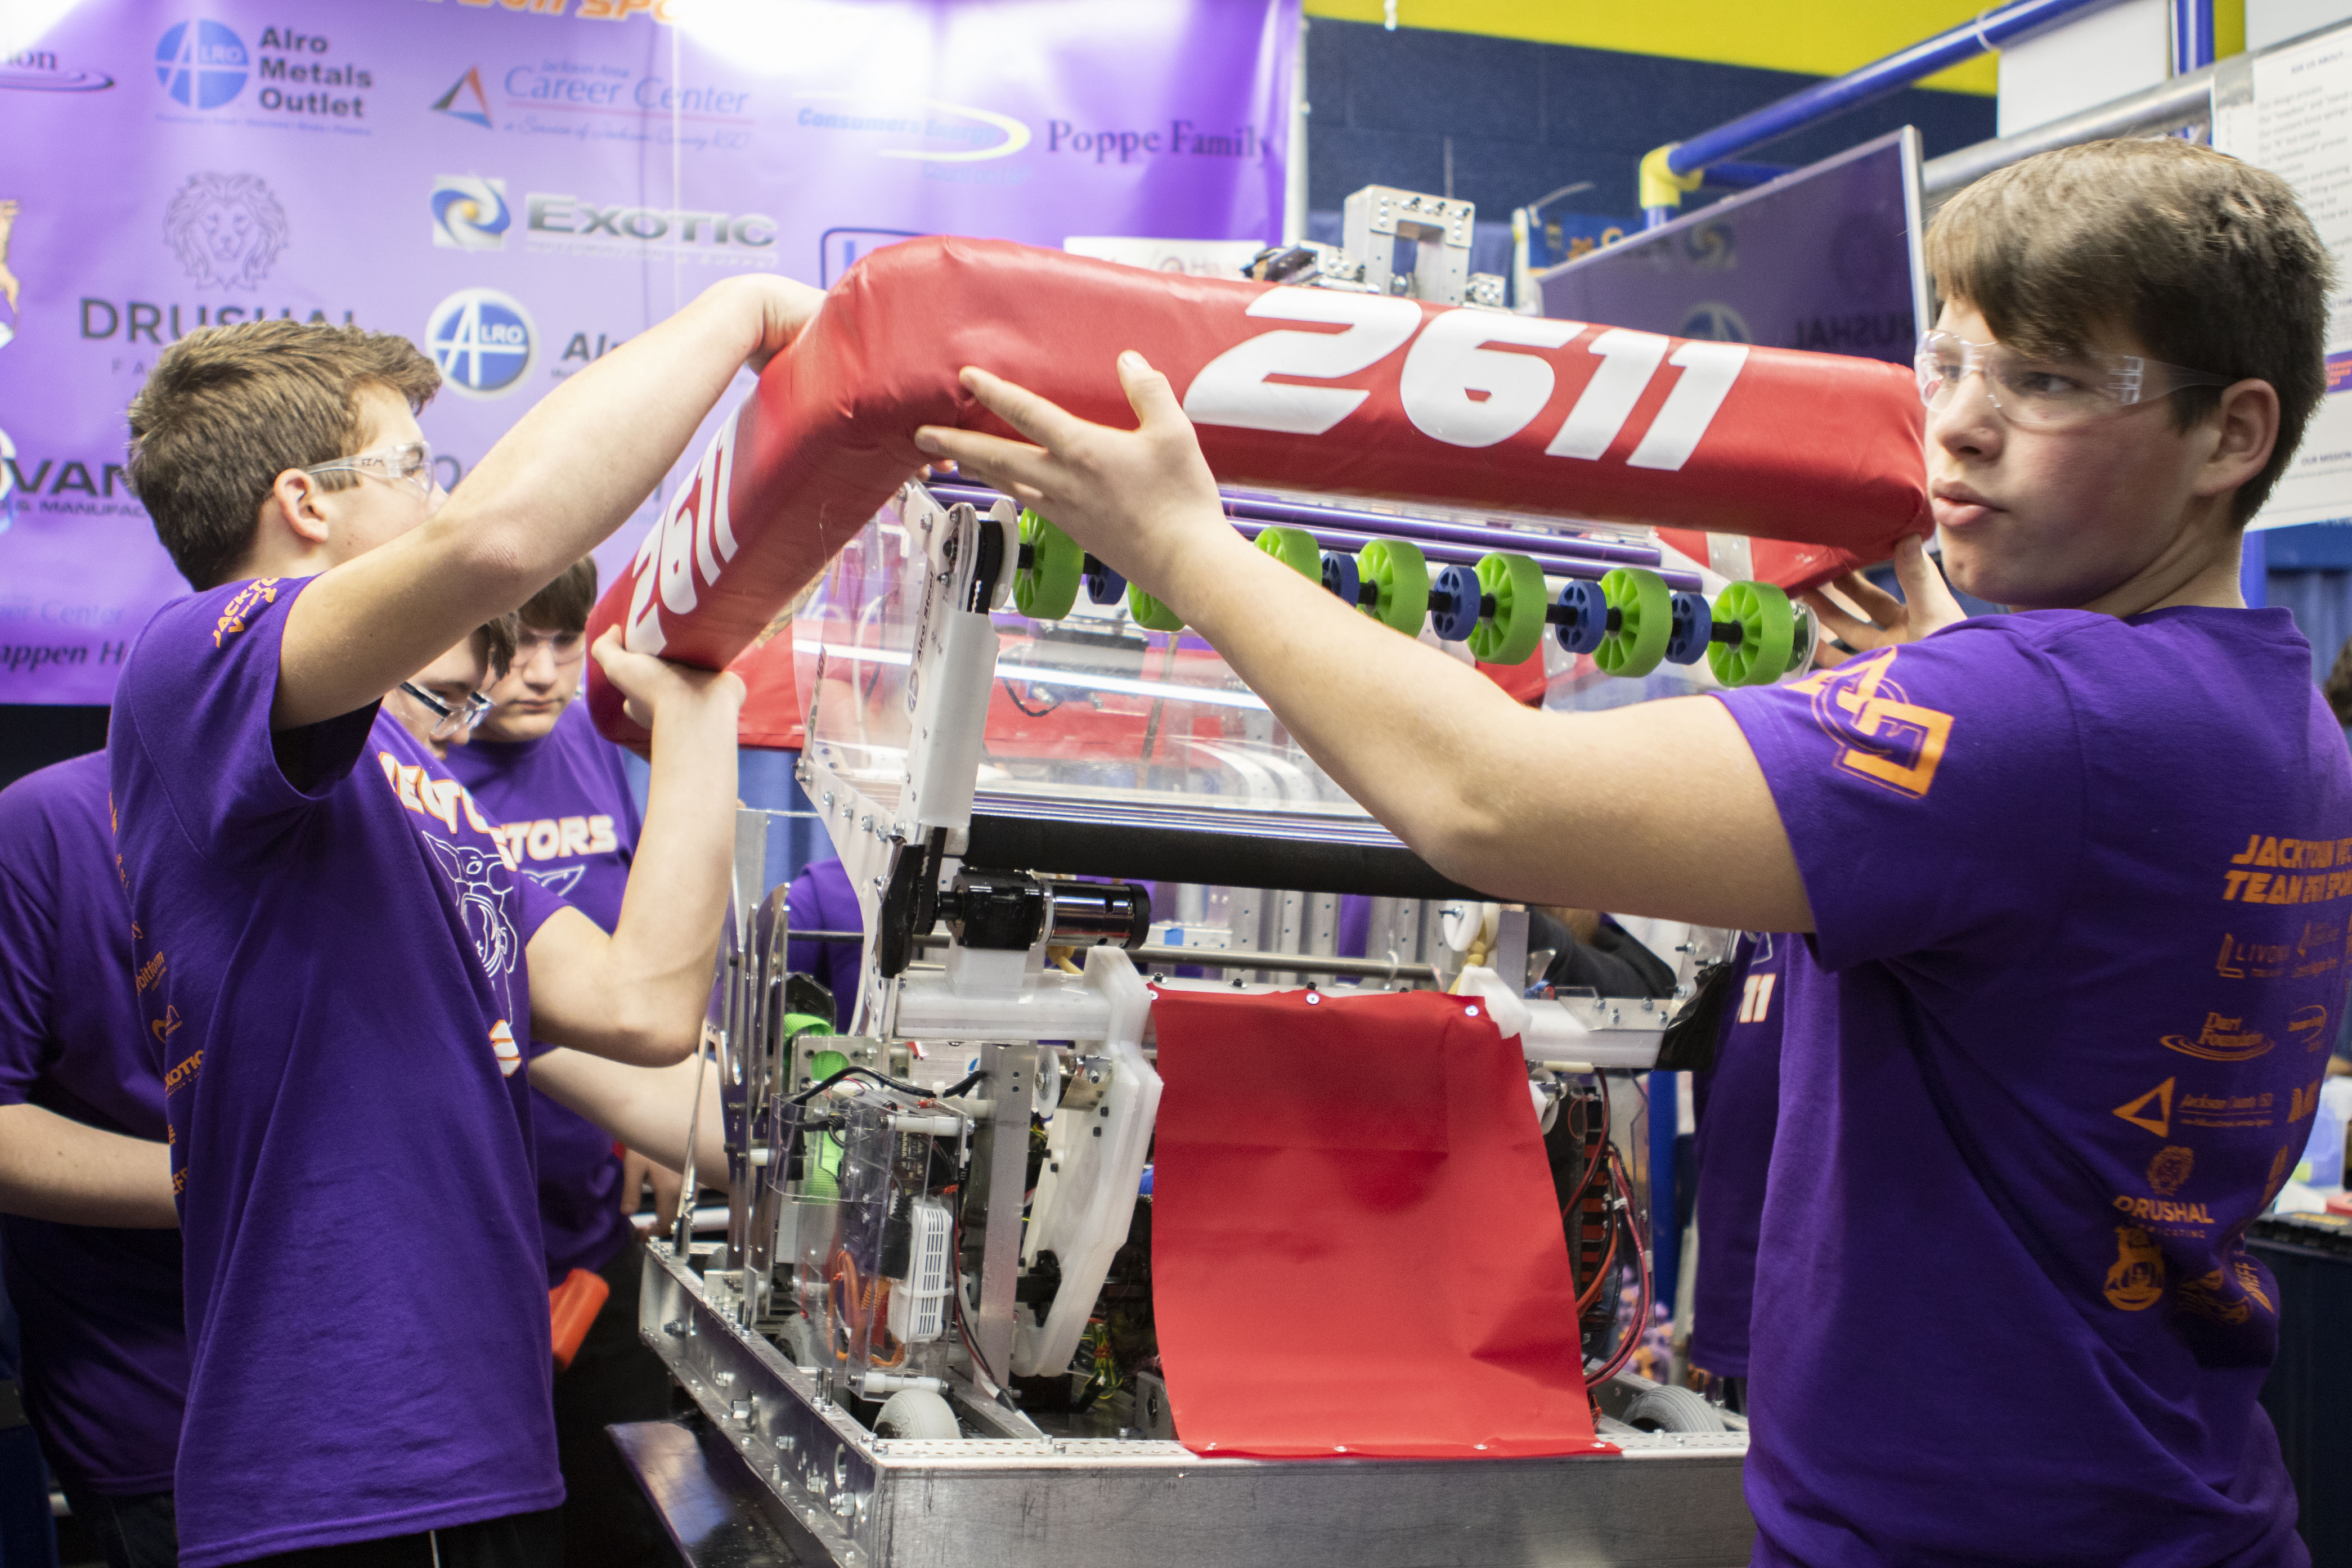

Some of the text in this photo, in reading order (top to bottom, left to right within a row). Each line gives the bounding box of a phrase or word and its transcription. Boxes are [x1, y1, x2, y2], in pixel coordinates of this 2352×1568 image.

[259, 27, 329, 55] Alro
[259, 56, 373, 89] Metals
[502, 65, 752, 114] Career Center
[259, 87, 365, 118] Outlet
[797, 107, 921, 136] Consumers
[1048, 120, 1273, 168] Poppe Family
[527, 195, 777, 248] EXOTIC
[79, 298, 355, 345] DRUS
[1184, 286, 1750, 471] 2611
[626, 383, 757, 657] 2611
[917, 570, 934, 662] Alro Steel
[2223, 870, 2304, 905] TEAM
[1739, 973, 1776, 1023] 11
[2113, 1195, 2215, 1224] DRUSHAL
